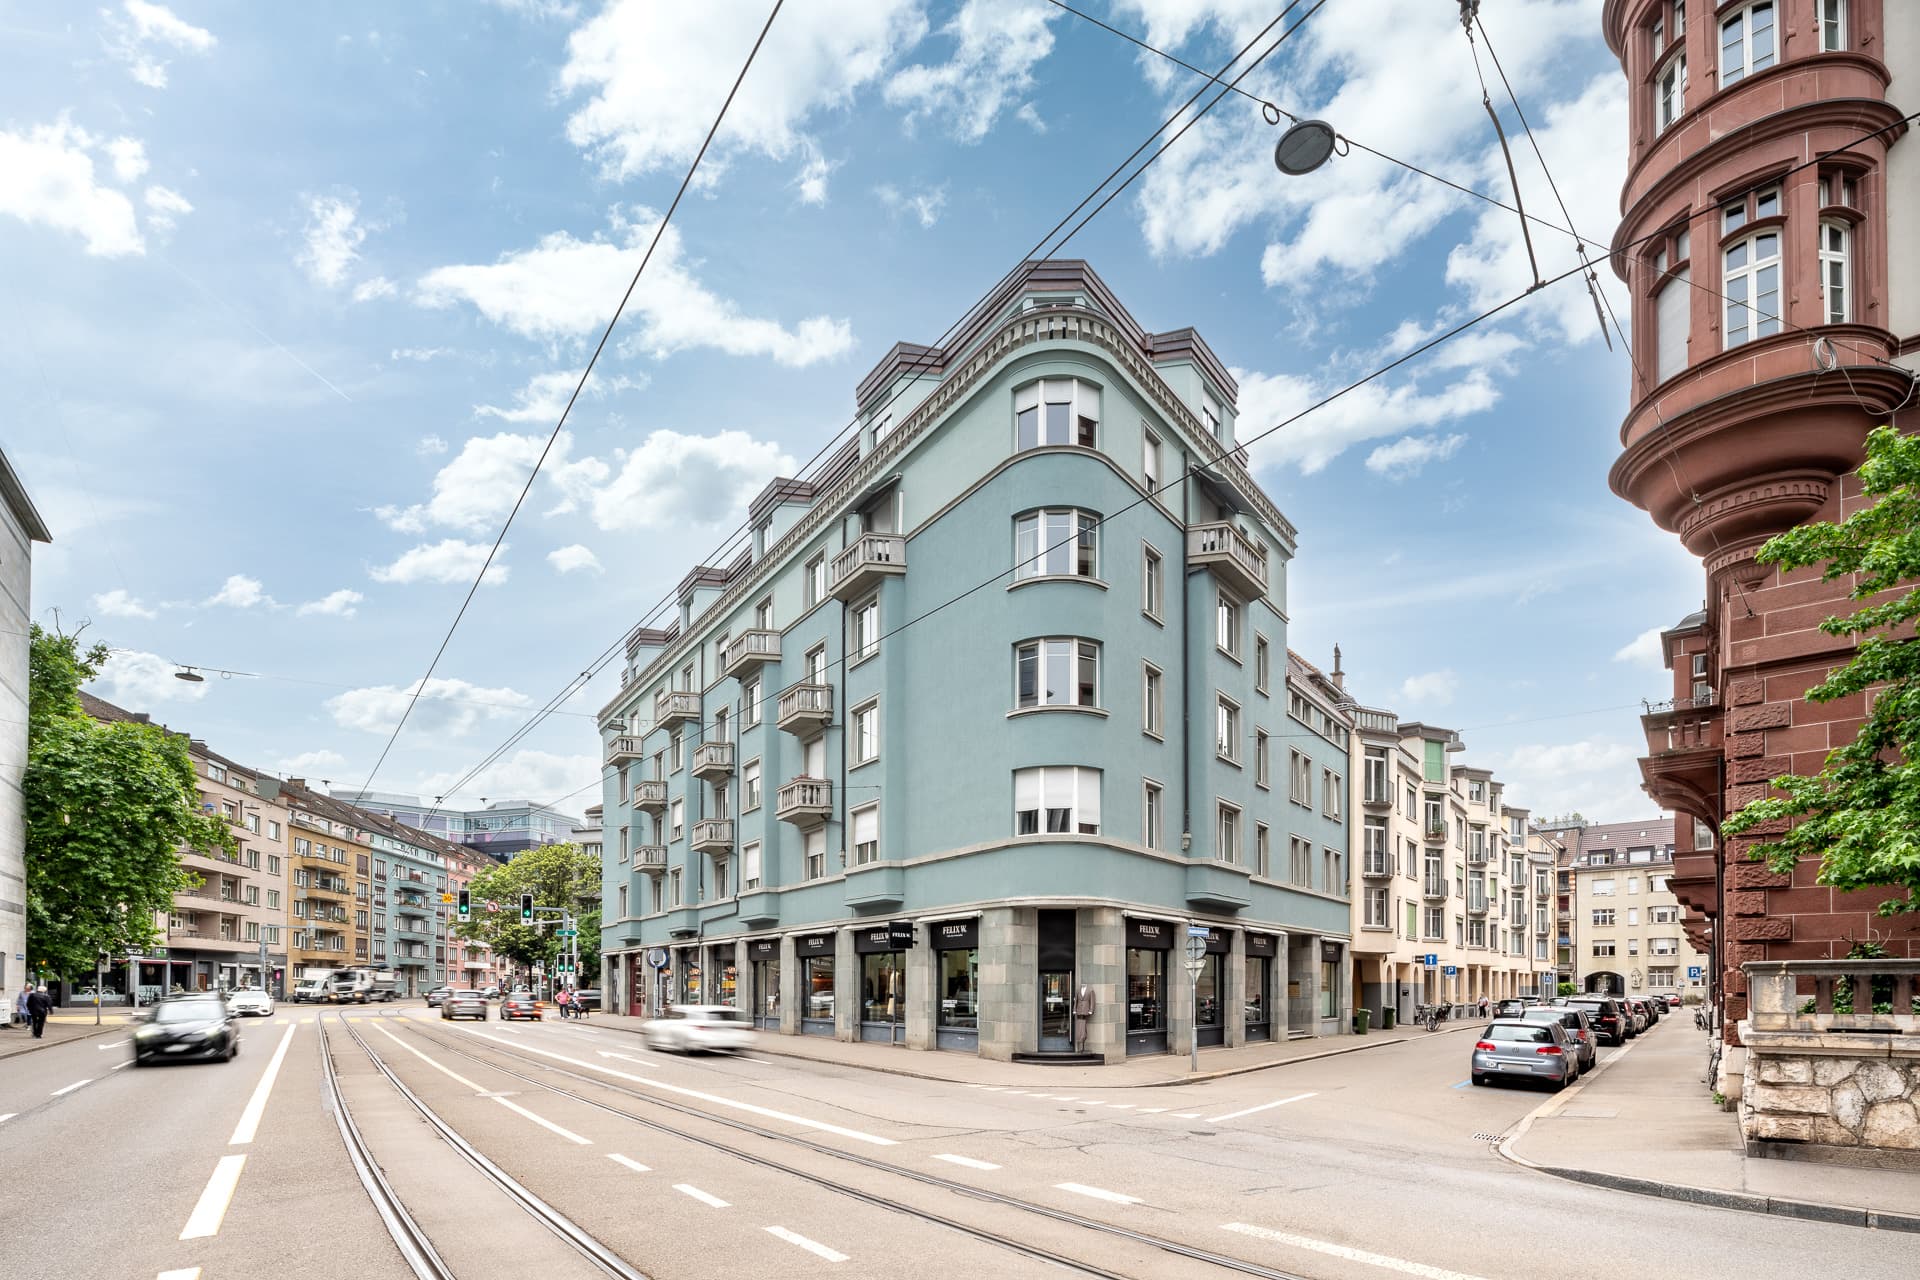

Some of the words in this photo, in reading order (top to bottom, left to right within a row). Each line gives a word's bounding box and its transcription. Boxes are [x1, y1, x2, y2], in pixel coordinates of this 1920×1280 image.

[942, 926, 960, 935] FELIX
[1139, 925, 1155, 934] FELIX
[1690, 968, 1698, 977] P
